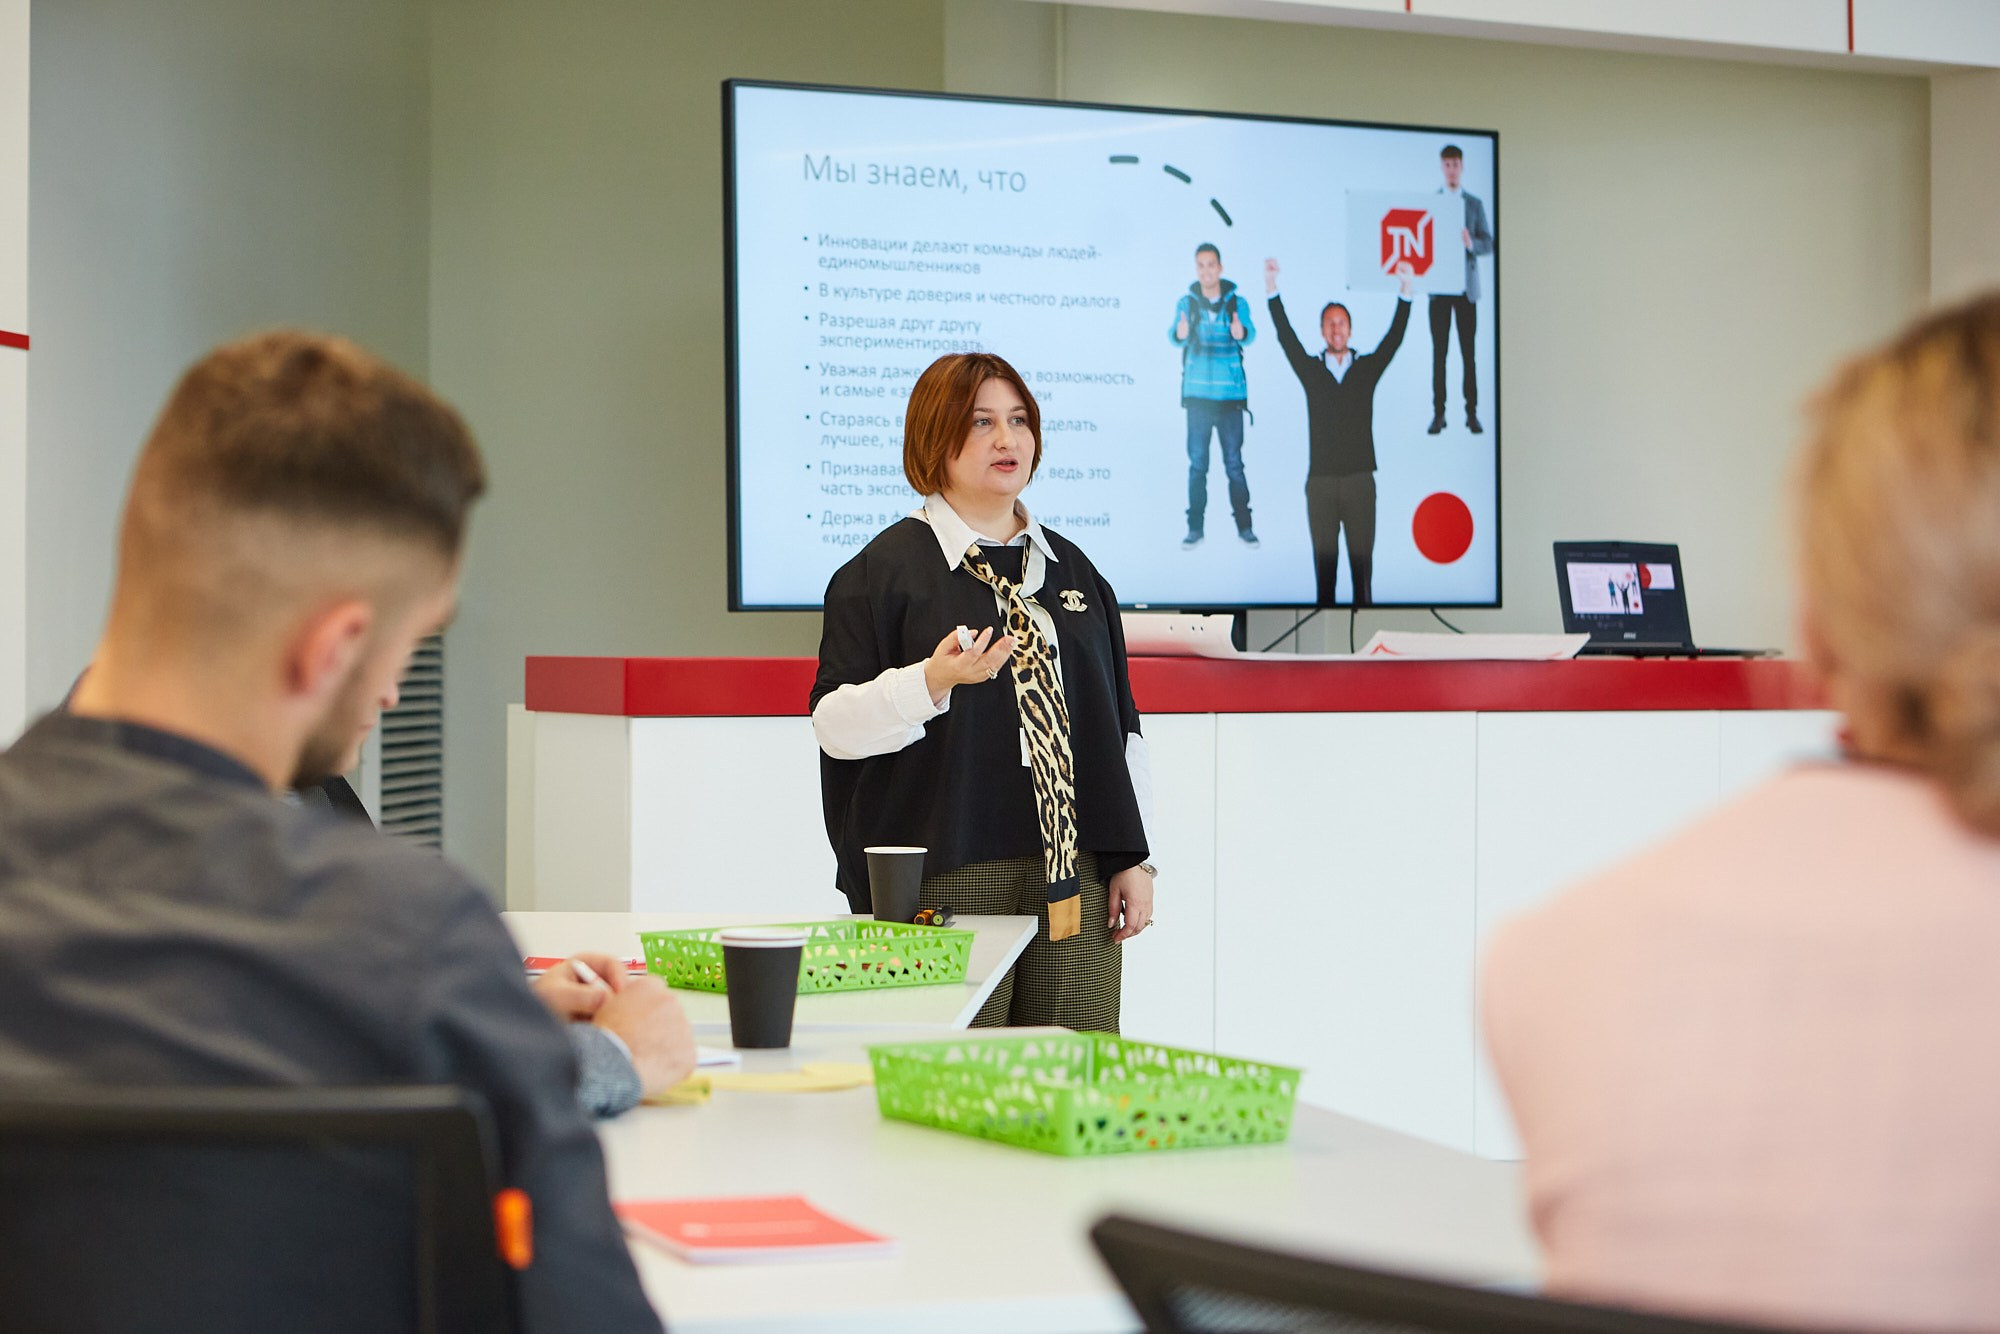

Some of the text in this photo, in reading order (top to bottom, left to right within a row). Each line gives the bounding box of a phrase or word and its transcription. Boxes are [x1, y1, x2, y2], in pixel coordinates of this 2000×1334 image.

[803, 153, 1027, 194] Мы знаем, что
[818, 233, 1102, 261] Инновации делают команды людей-
[818, 256, 981, 275] единомышленников
[819, 282, 1121, 310] В культуре доверия и честного диалога
[819, 312, 982, 335] Разрешая друг другу
[819, 334, 984, 353] экспериментировать
[820, 361, 877, 378] Уважая
[881, 366, 922, 381] даже
[1035, 371, 1135, 386] возможность
[820, 384, 830, 397] и
[834, 384, 886, 399] самые
[820, 410, 891, 430] Стараясь
[1040, 419, 1098, 434] сделать
[820, 433, 885, 450] лучшее,
[1048, 467, 1084, 482] ведь
[1087, 468, 1112, 480] это
[820, 483, 864, 497] часть
[821, 509, 874, 528] Держа
[878, 513, 887, 526] в
[1043, 514, 1062, 527] не
[1066, 512, 1112, 528] некий
[822, 532, 876, 547] «идеа
